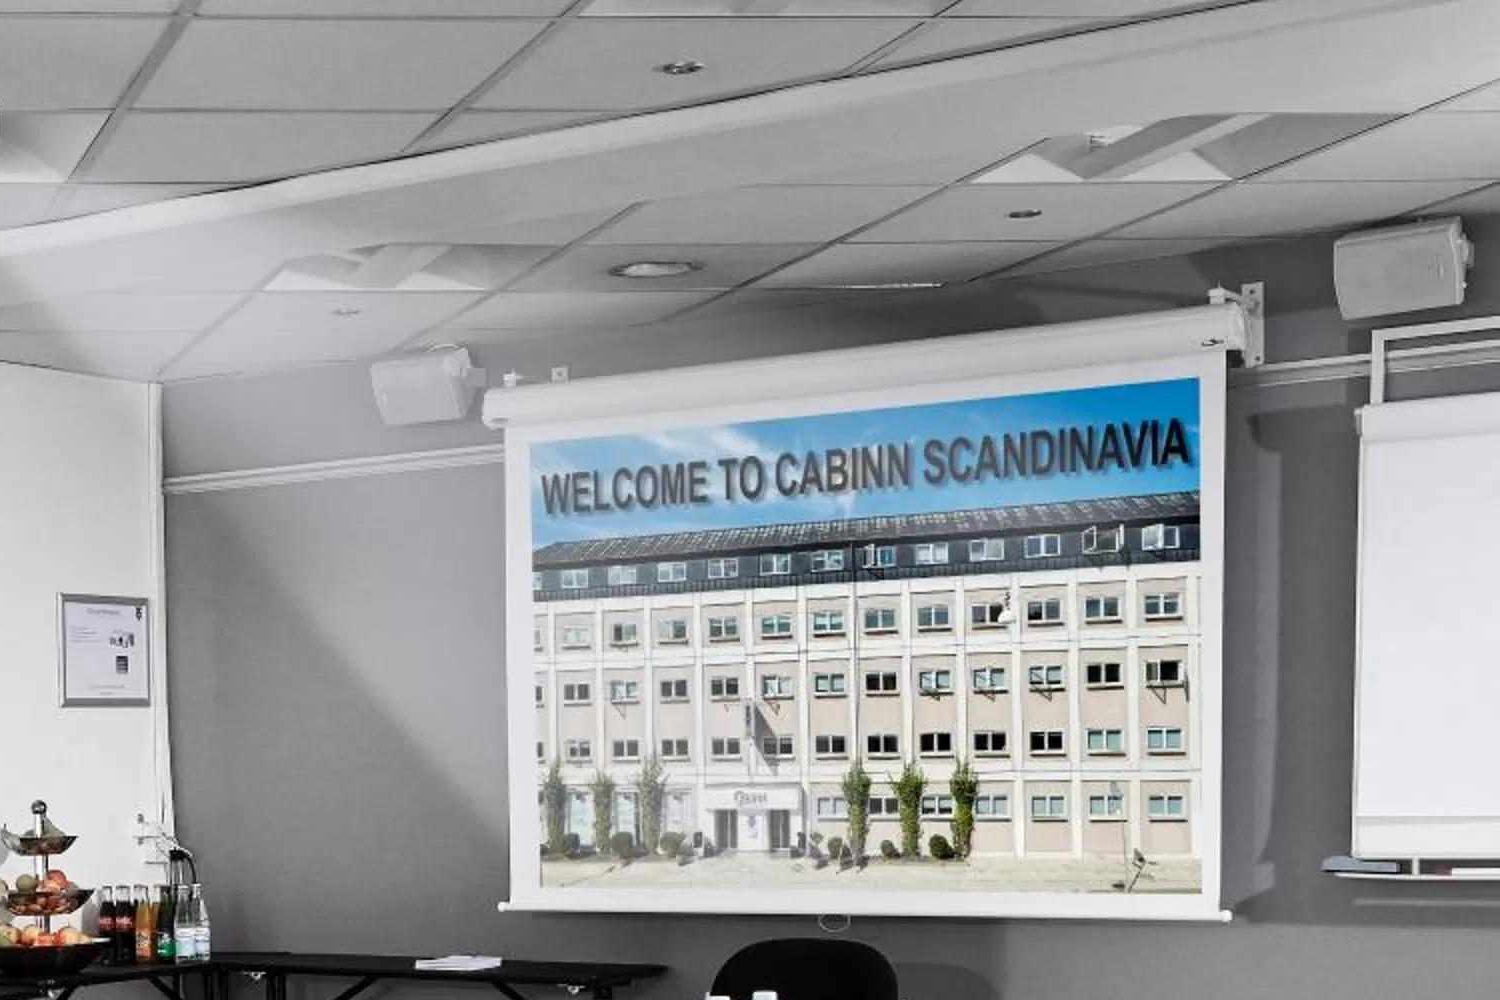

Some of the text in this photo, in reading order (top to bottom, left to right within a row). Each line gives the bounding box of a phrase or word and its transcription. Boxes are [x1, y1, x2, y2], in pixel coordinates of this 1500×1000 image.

[541, 417, 1190, 515] WELCOME TO CABINN SCANDINAVIA
